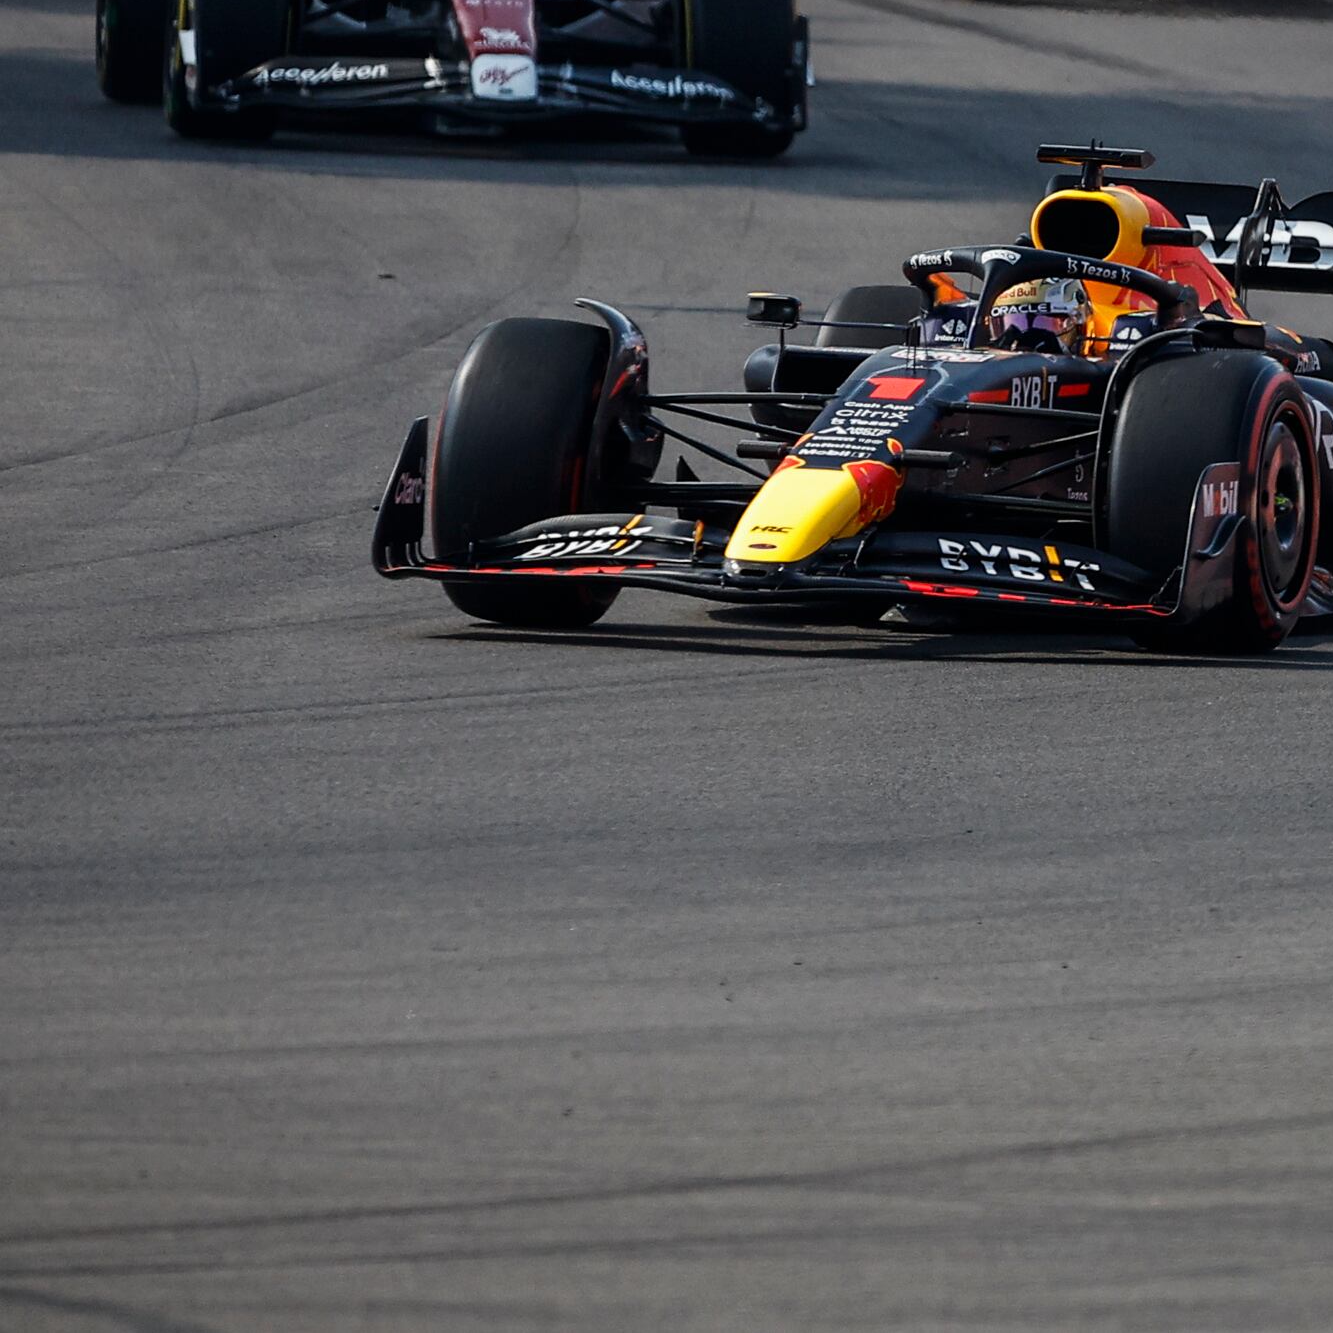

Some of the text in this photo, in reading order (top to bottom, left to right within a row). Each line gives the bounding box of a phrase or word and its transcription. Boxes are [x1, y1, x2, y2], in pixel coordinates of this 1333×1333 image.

[918, 253, 942, 266] Tezos
[1081, 261, 1118, 280] Tezos
[1016, 286, 1037, 297] Bull
[990, 303, 1049, 317] ORACLE
[867, 376, 926, 400] 1
[835, 408, 909, 420] citrix
[798, 448, 852, 457] Mobil
[751, 525, 794, 534] HRC
[937, 537, 1100, 592] BYBIT
